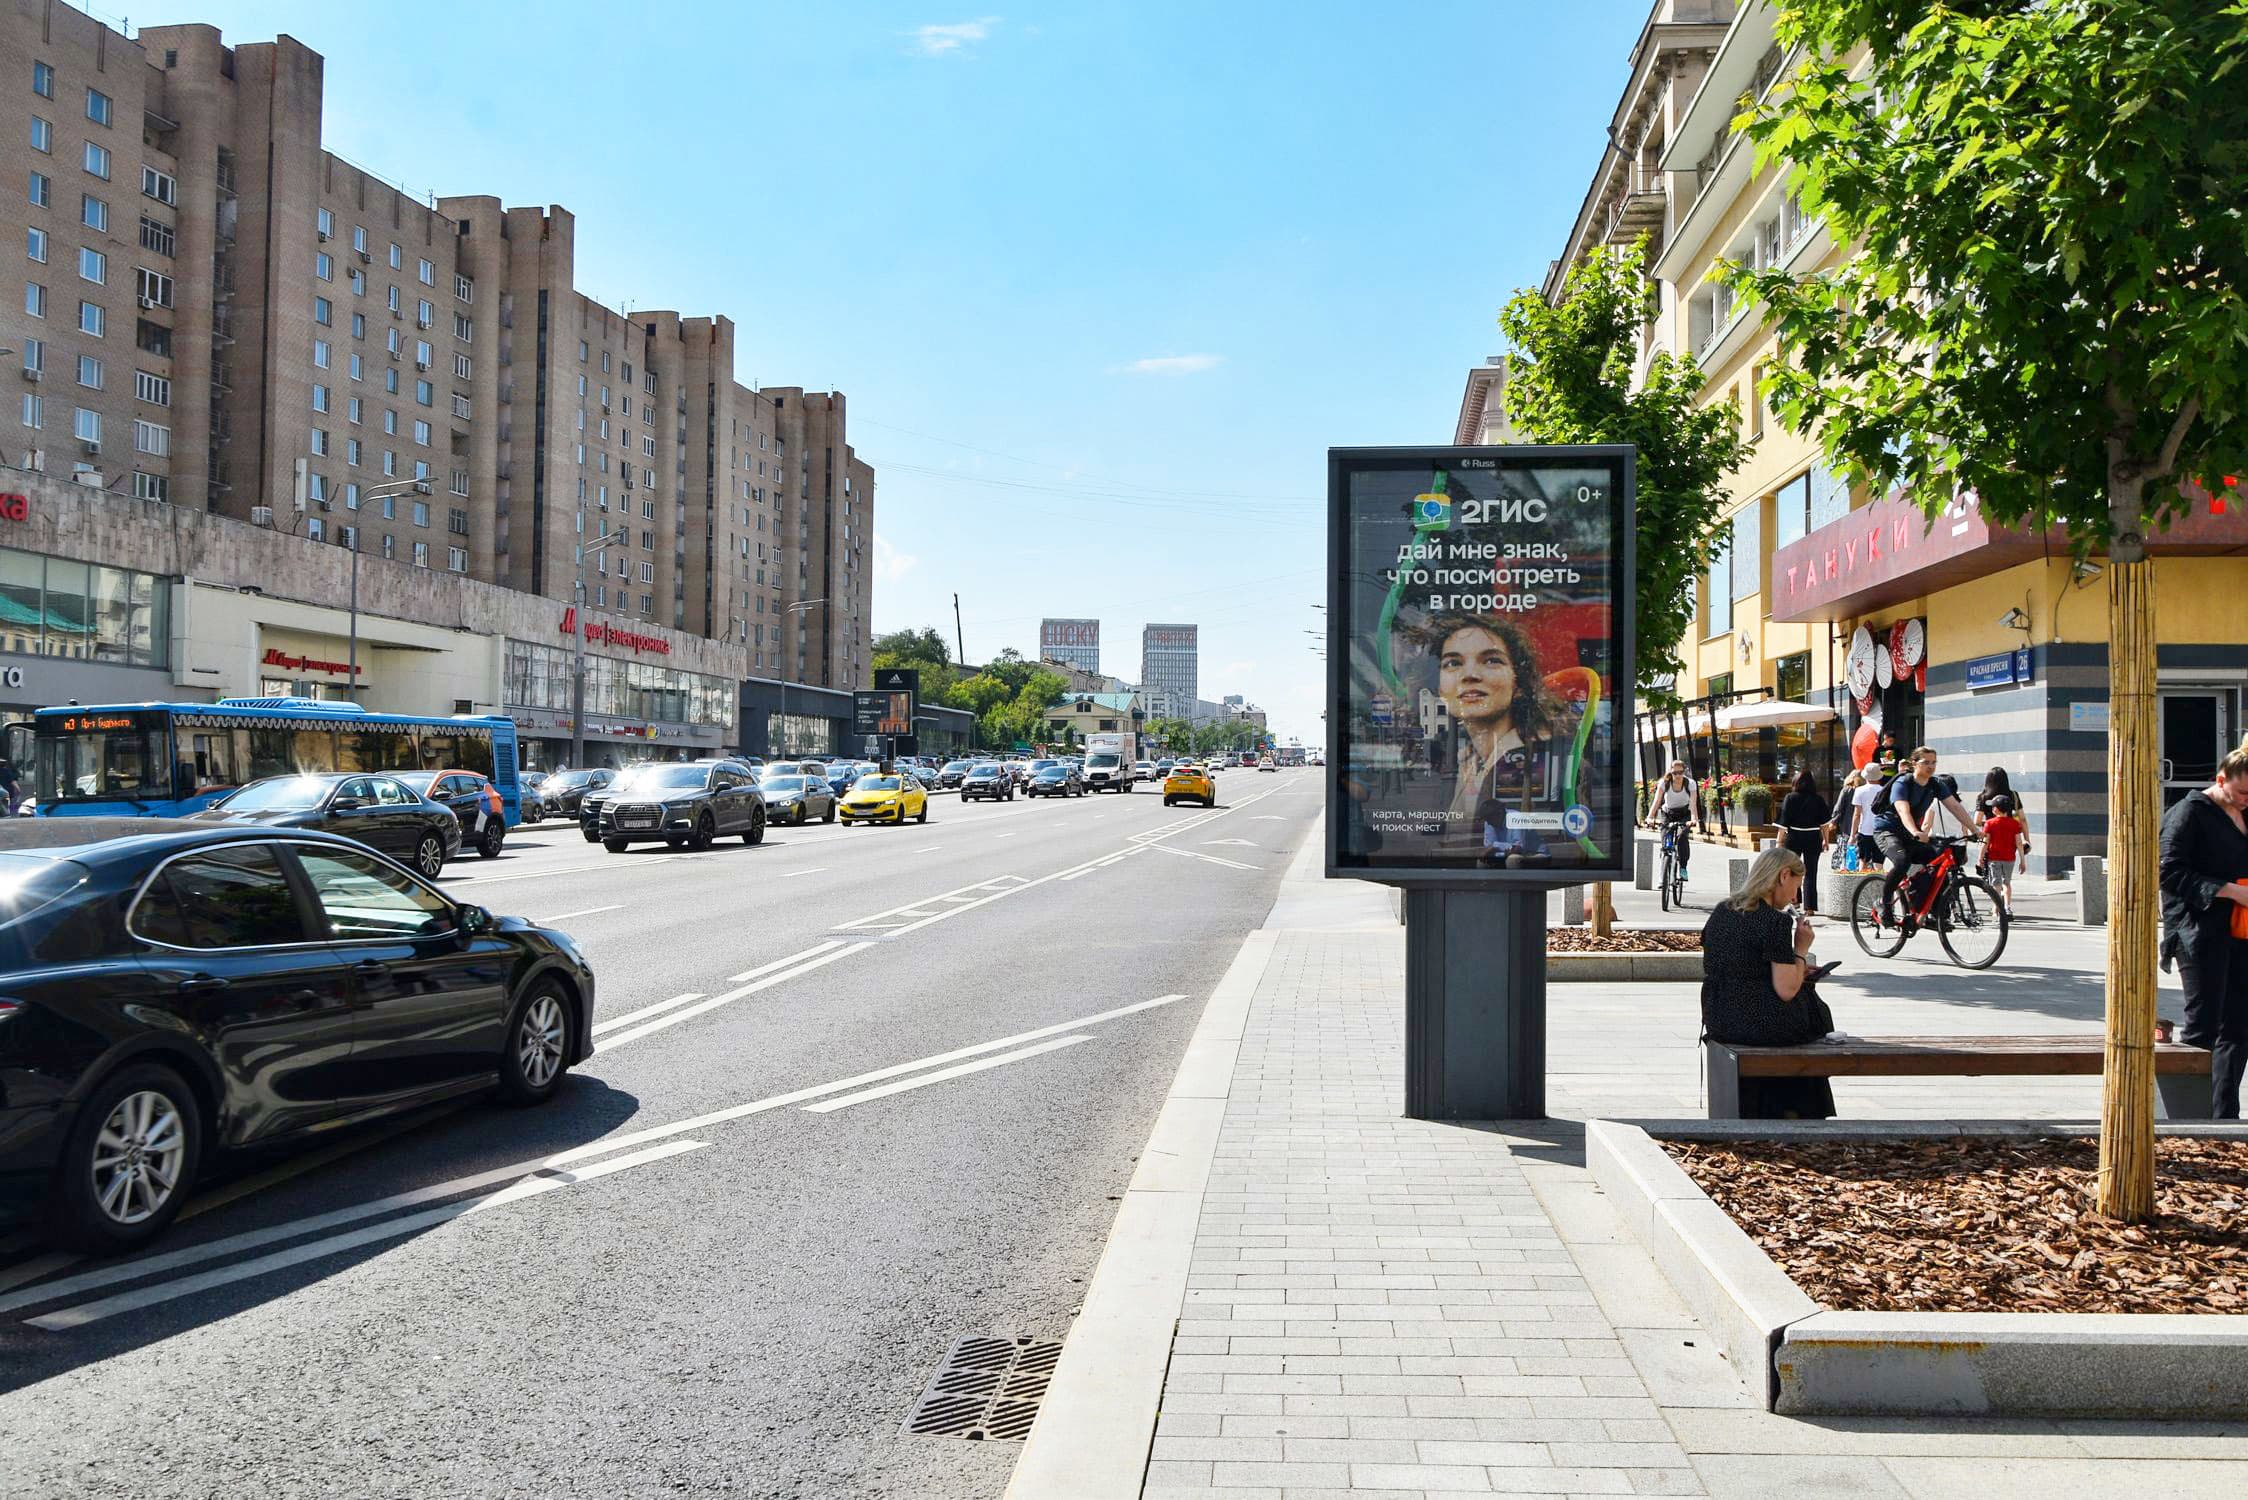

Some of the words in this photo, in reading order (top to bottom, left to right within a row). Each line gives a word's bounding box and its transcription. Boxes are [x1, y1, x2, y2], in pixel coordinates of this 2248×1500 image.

[1472, 459, 1495, 468] Russ
[1577, 486, 1602, 503] 0+
[1461, 499, 1547, 524] 2ГИС
[1397, 538, 1442, 563] дай
[1450, 543, 1497, 560] мне
[1503, 543, 1568, 563] знак,
[1787, 513, 1909, 595] ТАНУКИ
[1387, 568, 1428, 585] что
[1435, 568, 1580, 589] посмотреть
[1430, 594, 1443, 610] в
[1450, 593, 1537, 615] городе
[1043, 623, 1099, 646] LUCKY
[2018, 655, 2028, 671] 26
[1372, 810, 1406, 821] карта,
[1408, 810, 1464, 822] маршруты
[1382, 822, 1413, 832] поиск
[1415, 823, 1440, 832] мест
